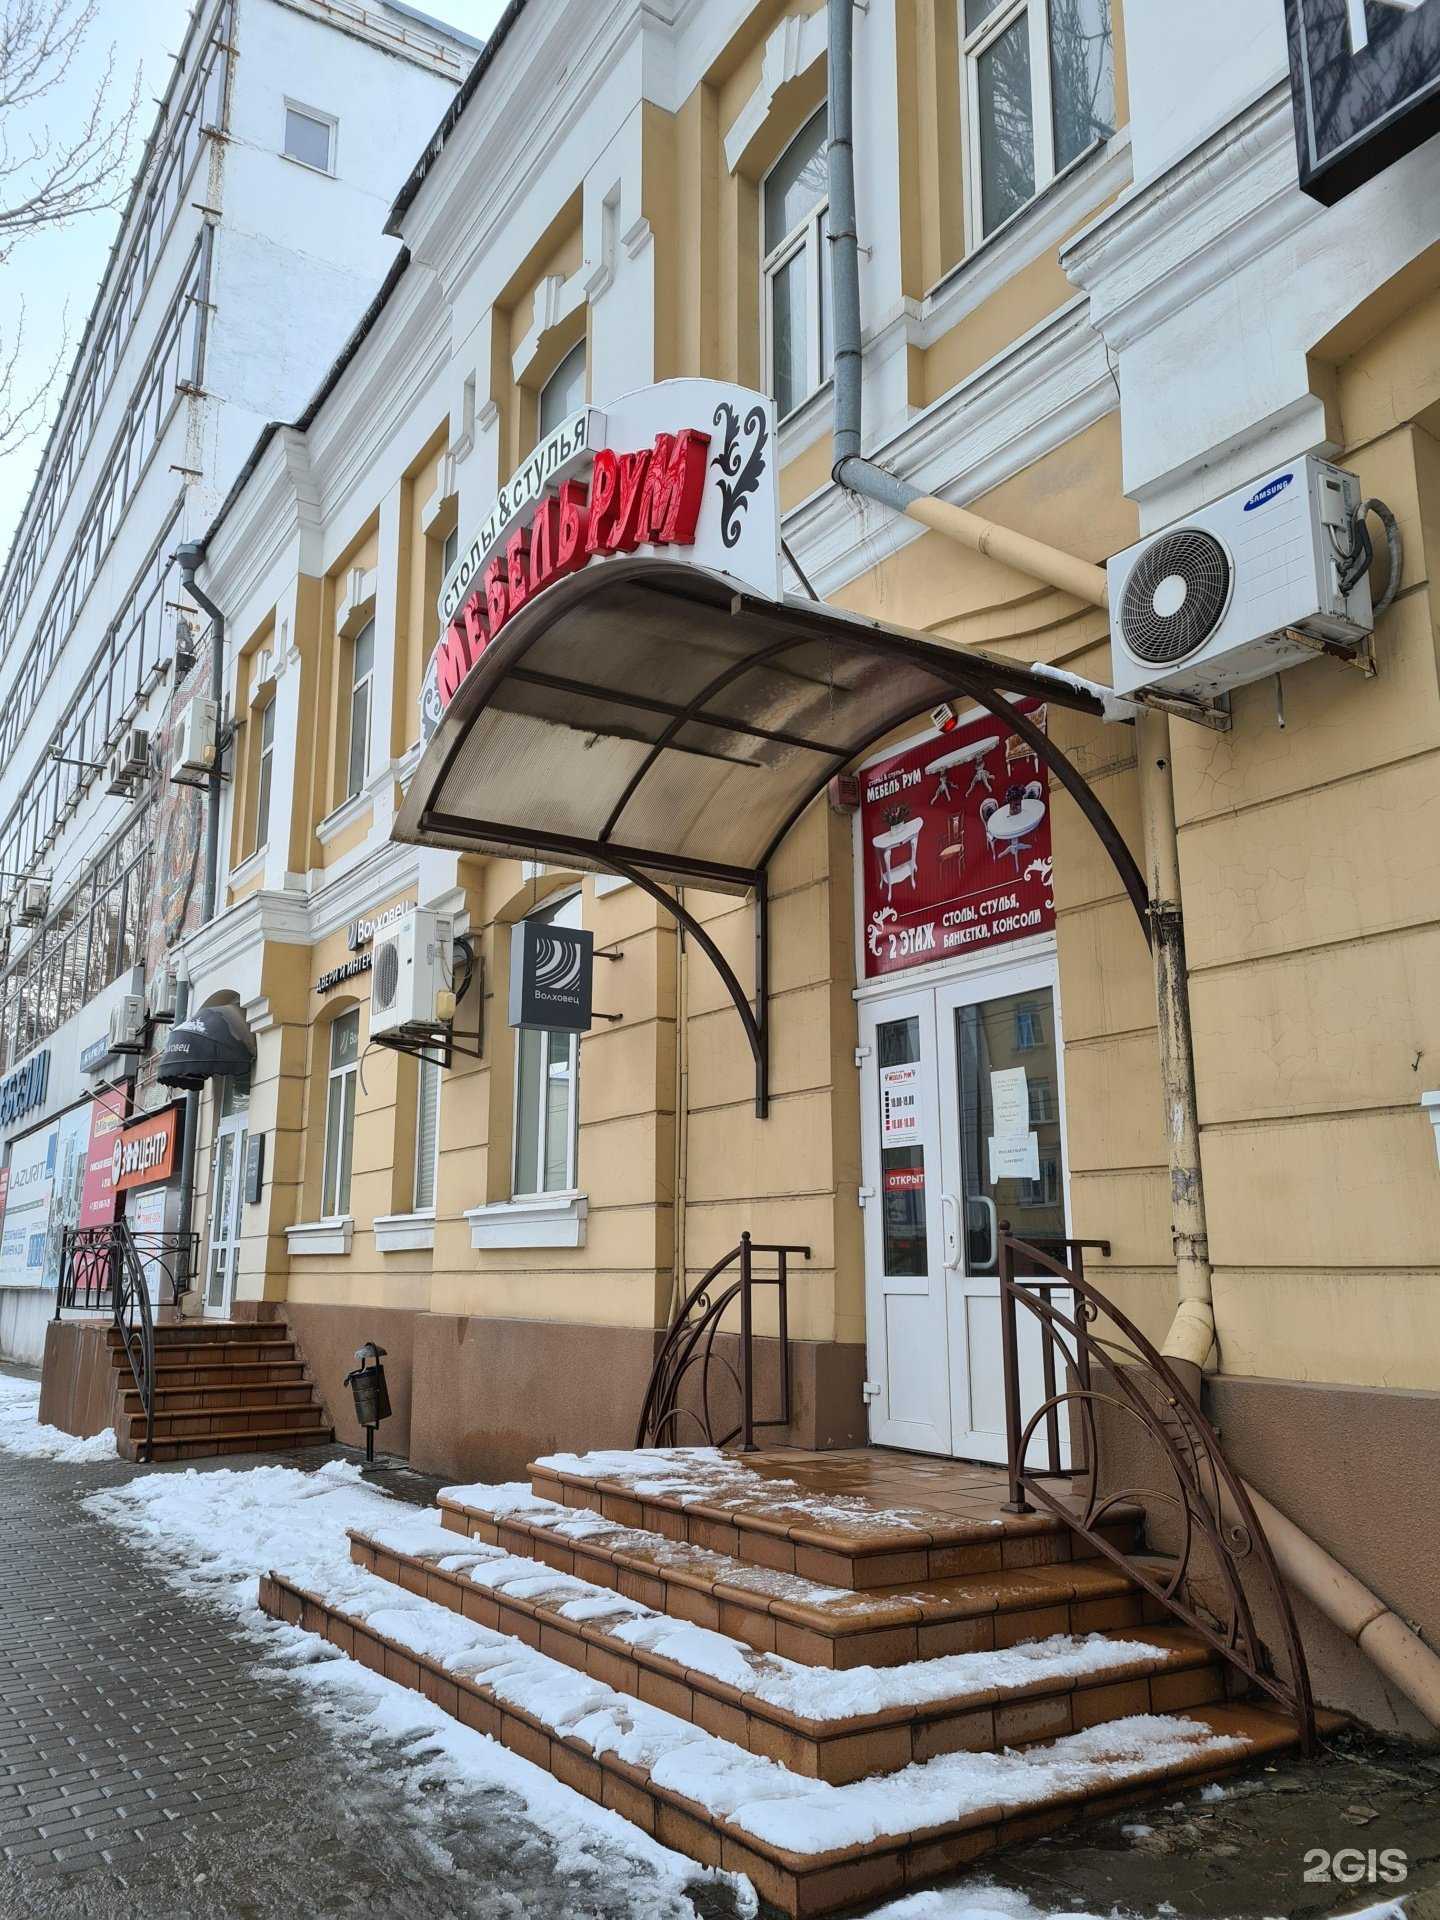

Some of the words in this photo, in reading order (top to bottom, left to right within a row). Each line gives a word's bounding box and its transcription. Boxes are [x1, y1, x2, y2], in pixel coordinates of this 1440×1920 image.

[1248, 481, 1289, 505] SAMSUNG
[443, 519, 496, 618] СТОЛЫ
[499, 489, 511, 528] &
[513, 415, 586, 501] СТУЛЬЯ
[436, 480, 586, 706] МЕБЕЛЬ
[585, 429, 706, 553] РУМ
[902, 767, 921, 789] РУМ
[942, 906, 978, 927] СТОЛЫ,
[979, 893, 1020, 916] СТУЛЬЯ,
[888, 934, 897, 959] 2
[900, 922, 936, 955] ЭТАЖ
[943, 924, 991, 948] БАНКЕТКИ,
[992, 909, 1041, 935] КОНСОЛИ
[316, 968, 337, 991] ДВЕРИ
[347, 951, 373, 976] ИНТЕР
[534, 989, 580, 1007] Волховец
[889, 1174, 924, 1186] ОТКРЫТ
